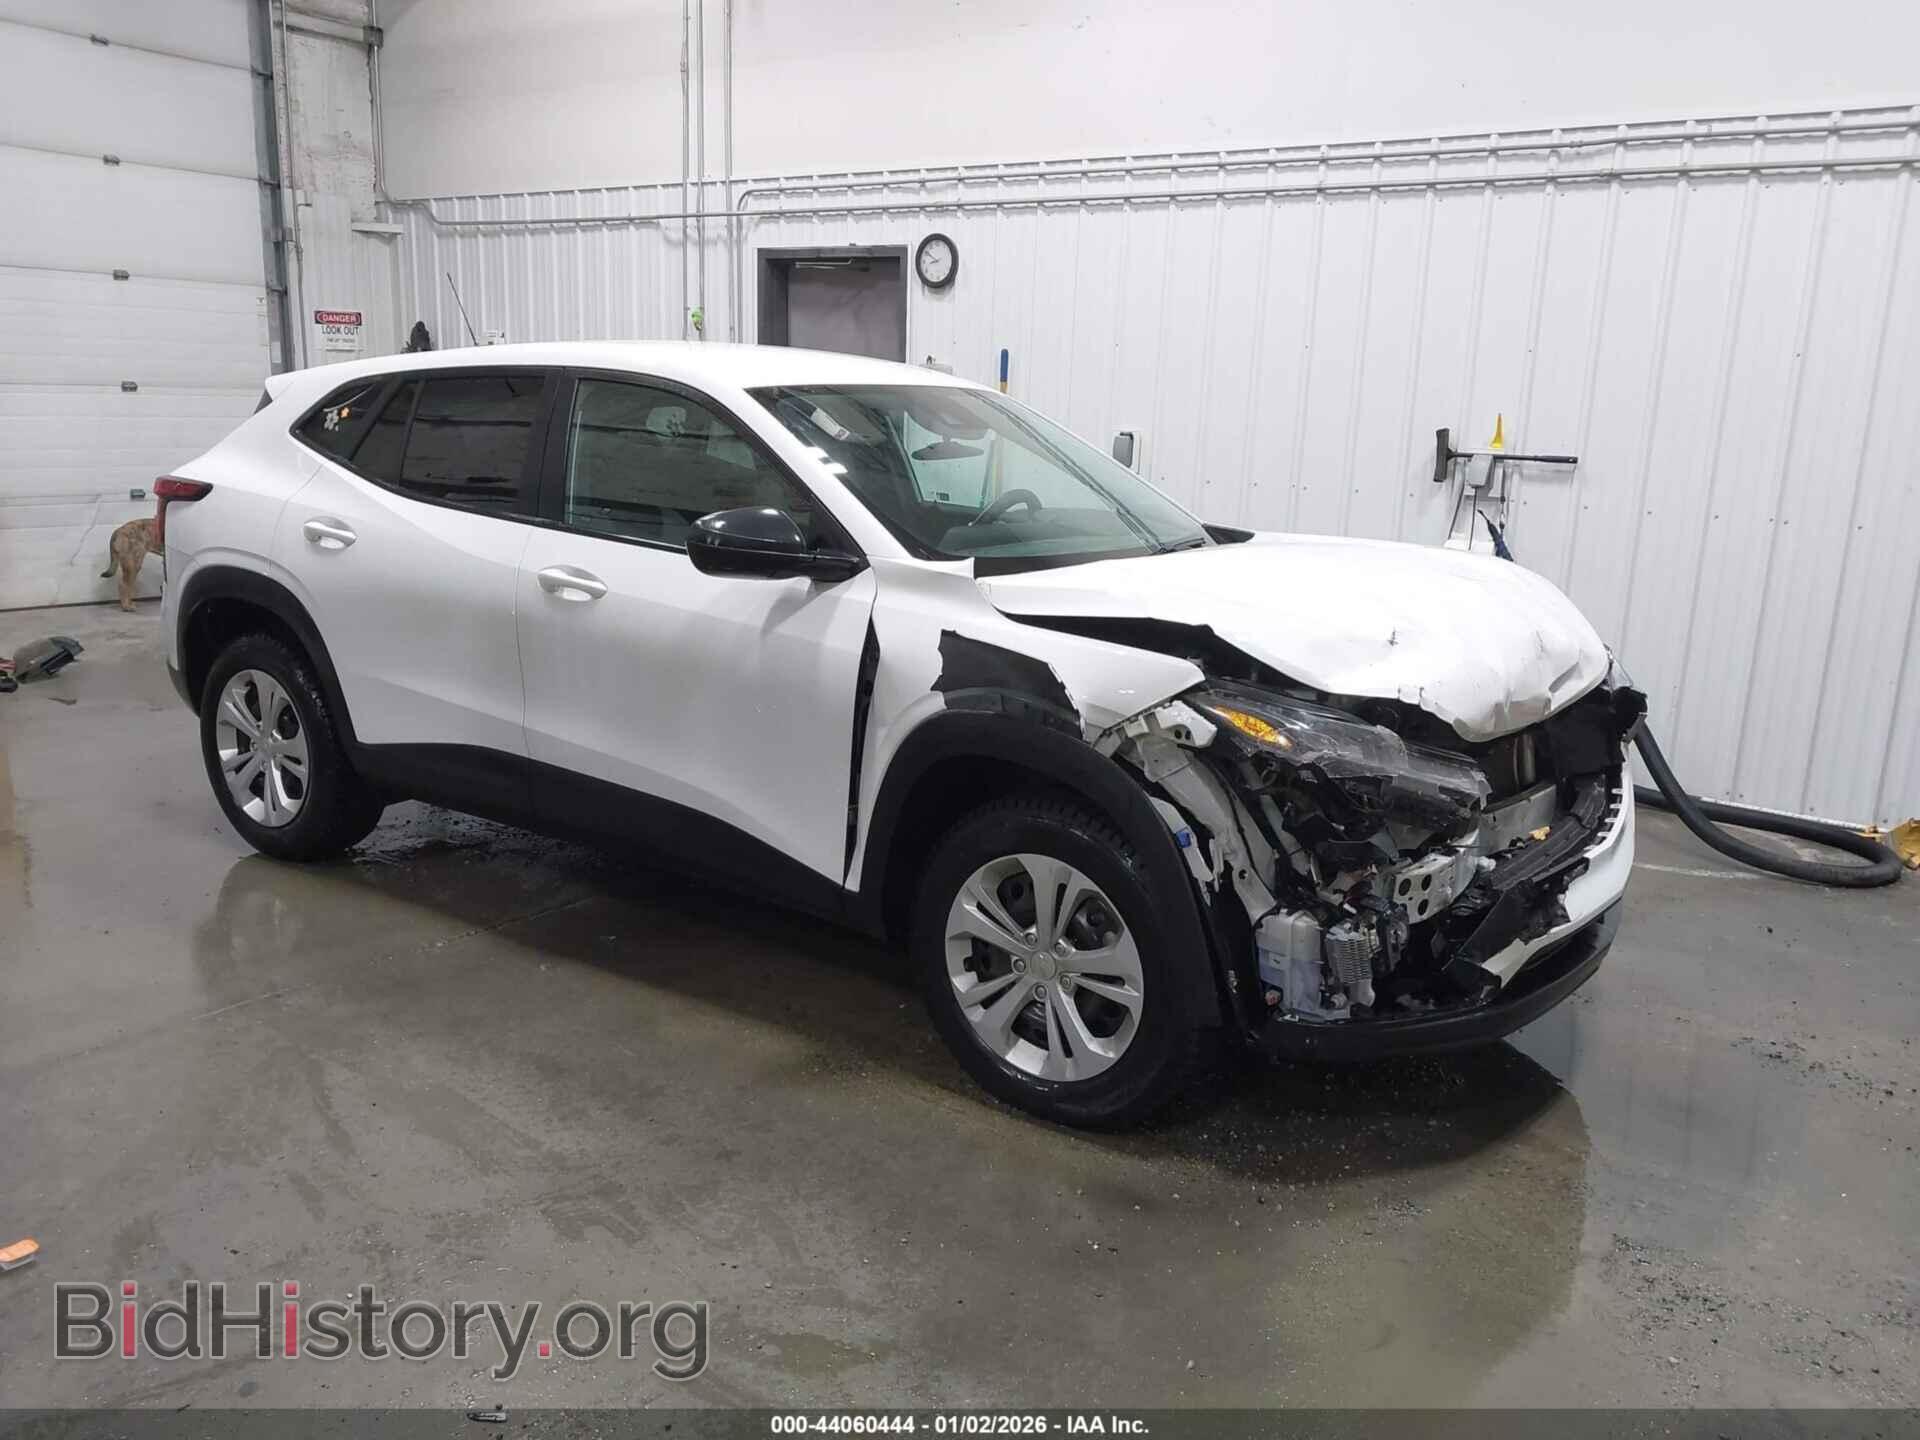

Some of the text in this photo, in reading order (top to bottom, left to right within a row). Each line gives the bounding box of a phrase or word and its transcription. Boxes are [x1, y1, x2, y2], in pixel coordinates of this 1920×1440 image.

[322, 313, 357, 323] DANGER
[321, 326, 359, 336] LOOK OUT
